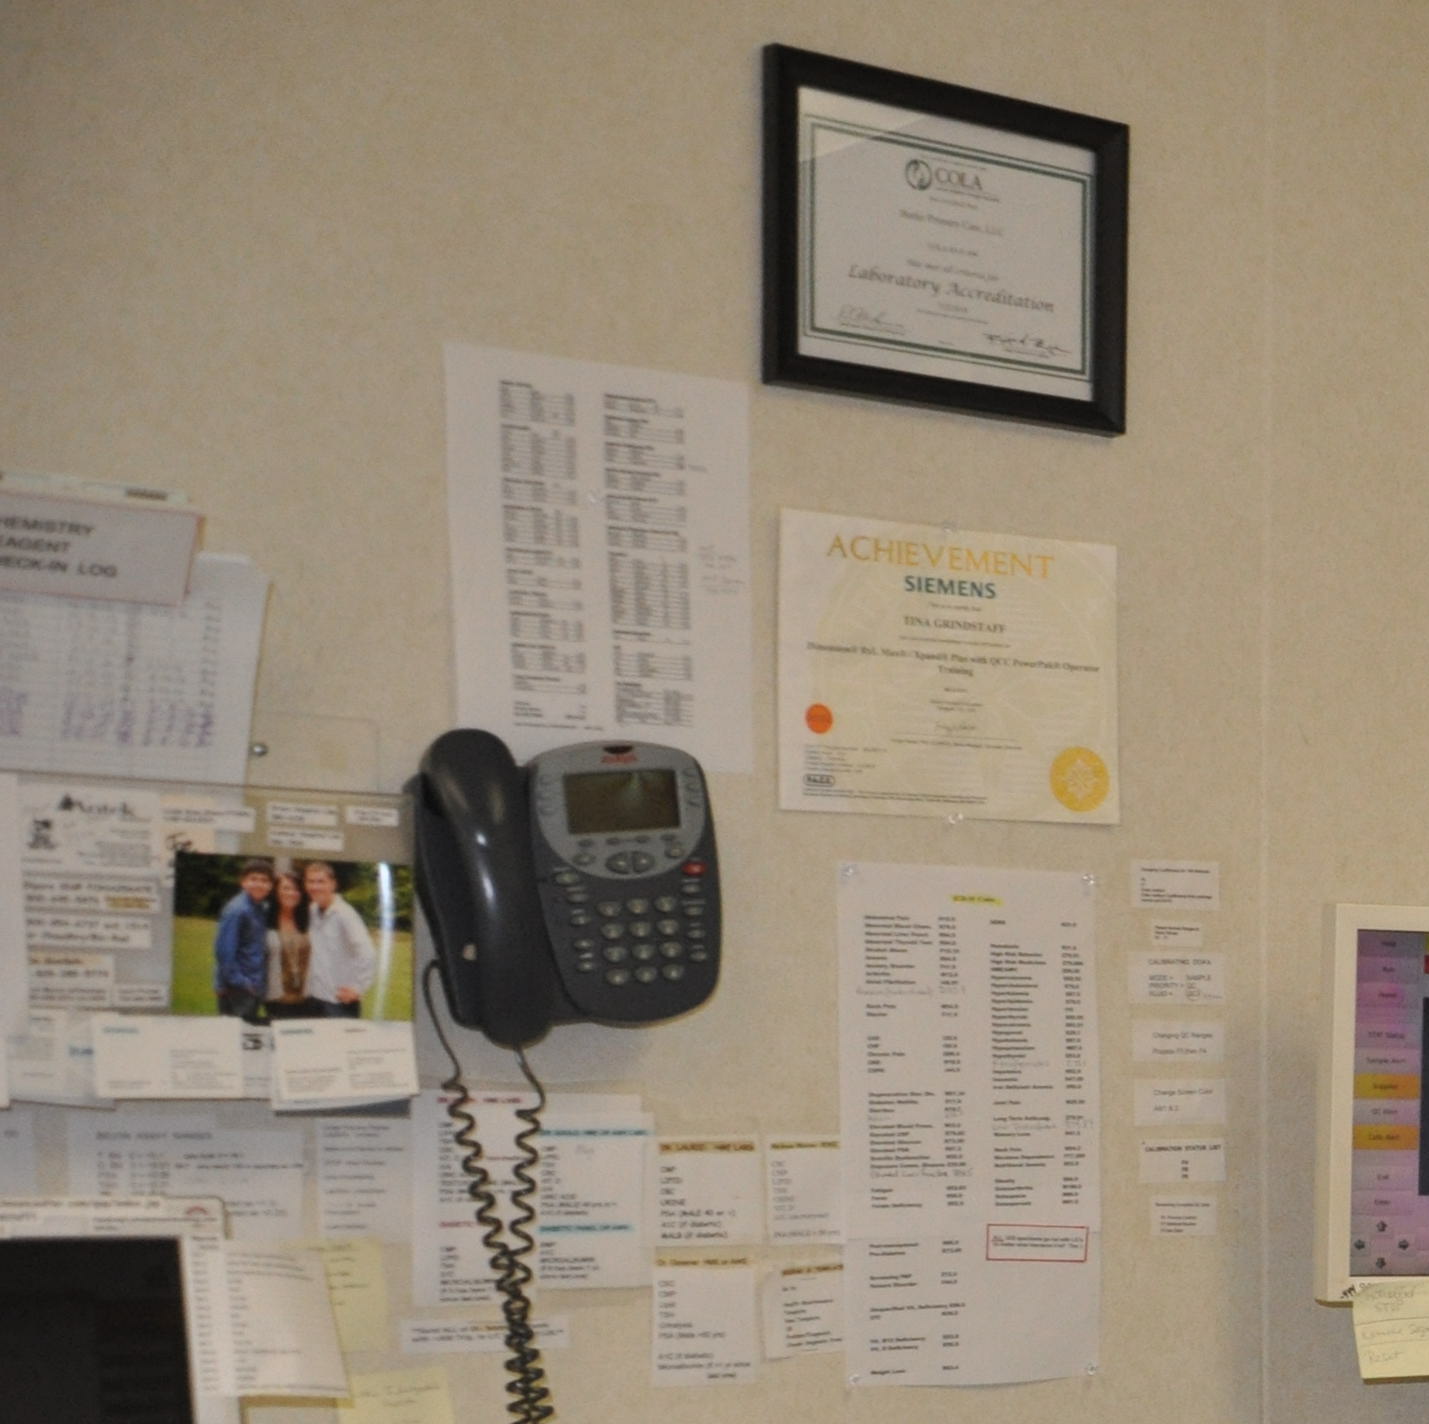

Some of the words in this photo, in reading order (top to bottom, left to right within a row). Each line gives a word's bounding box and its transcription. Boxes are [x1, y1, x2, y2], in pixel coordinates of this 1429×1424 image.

[935, 167, 983, 190] COLA
[847, 263, 941, 295] Laboratory
[946, 281, 1054, 313] Accreditation
[0, 516, 95, 536] HEMISTRY
[0, 554, 67, 574] HECK-IN
[77, 562, 119, 578] LOG
[826, 535, 1055, 580] ACHIEVEMENT
[904, 575, 997, 600] SIEMENS
[903, 615, 930, 629] TINA
[934, 619, 1007, 634] GRINDSTAFF
[938, 664, 974, 677] Training
[1154, 1088, 1175, 1097] Change
